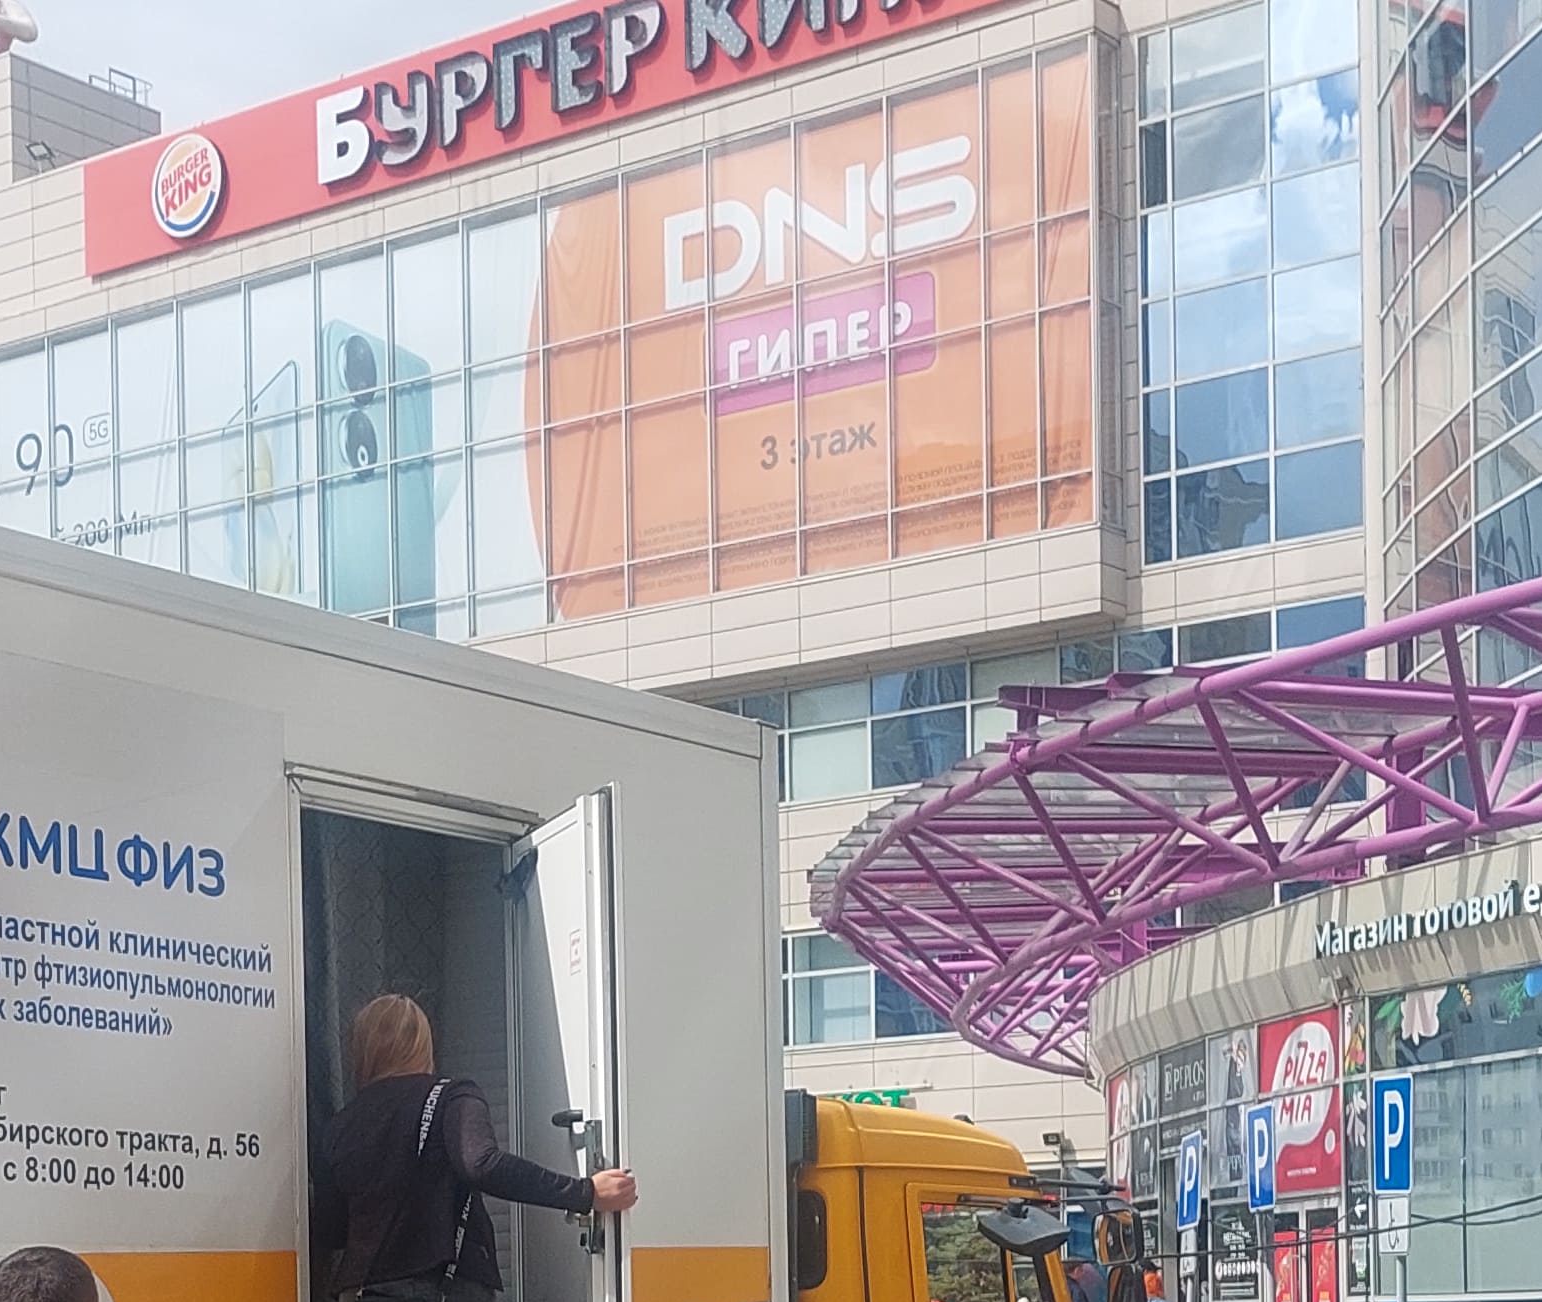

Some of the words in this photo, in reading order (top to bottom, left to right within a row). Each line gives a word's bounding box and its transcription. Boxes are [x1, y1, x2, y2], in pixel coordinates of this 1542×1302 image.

[316, 0, 666, 192] БУРГЕР
[161, 147, 209, 197] BURGER
[165, 162, 212, 219] KING
[663, 135, 977, 313] DNS
[727, 300, 913, 389] ГИПЕР
[16, 424, 74, 496] 90
[760, 435, 779, 471] 3
[792, 421, 878, 463] этаж
[73, 518, 109, 546] 200
[1314, 912, 1411, 960] Магазин
[1412, 879, 1517, 938] готовой
[109, 929, 272, 973] клинический
[34, 955, 275, 1010] фтизиопульмонологии
[14, 996, 173, 1037] заболеваний»
[1283, 1040, 1327, 1088] PIZZA
[1280, 1094, 1312, 1125] MIA
[1384, 1089, 1403, 1180] P
[116, 1131, 200, 1159] тракта,
[207, 1137, 229, 1159] д.
[235, 1133, 261, 1159] 56
[1254, 1117, 1269, 1199] P
[3, 1162, 17, 1182] с
[25, 1158, 77, 1185] 8:00
[84, 1165, 115, 1190] до
[123, 1162, 185, 1190] 14:00
[1184, 1145, 1197, 1218] P
